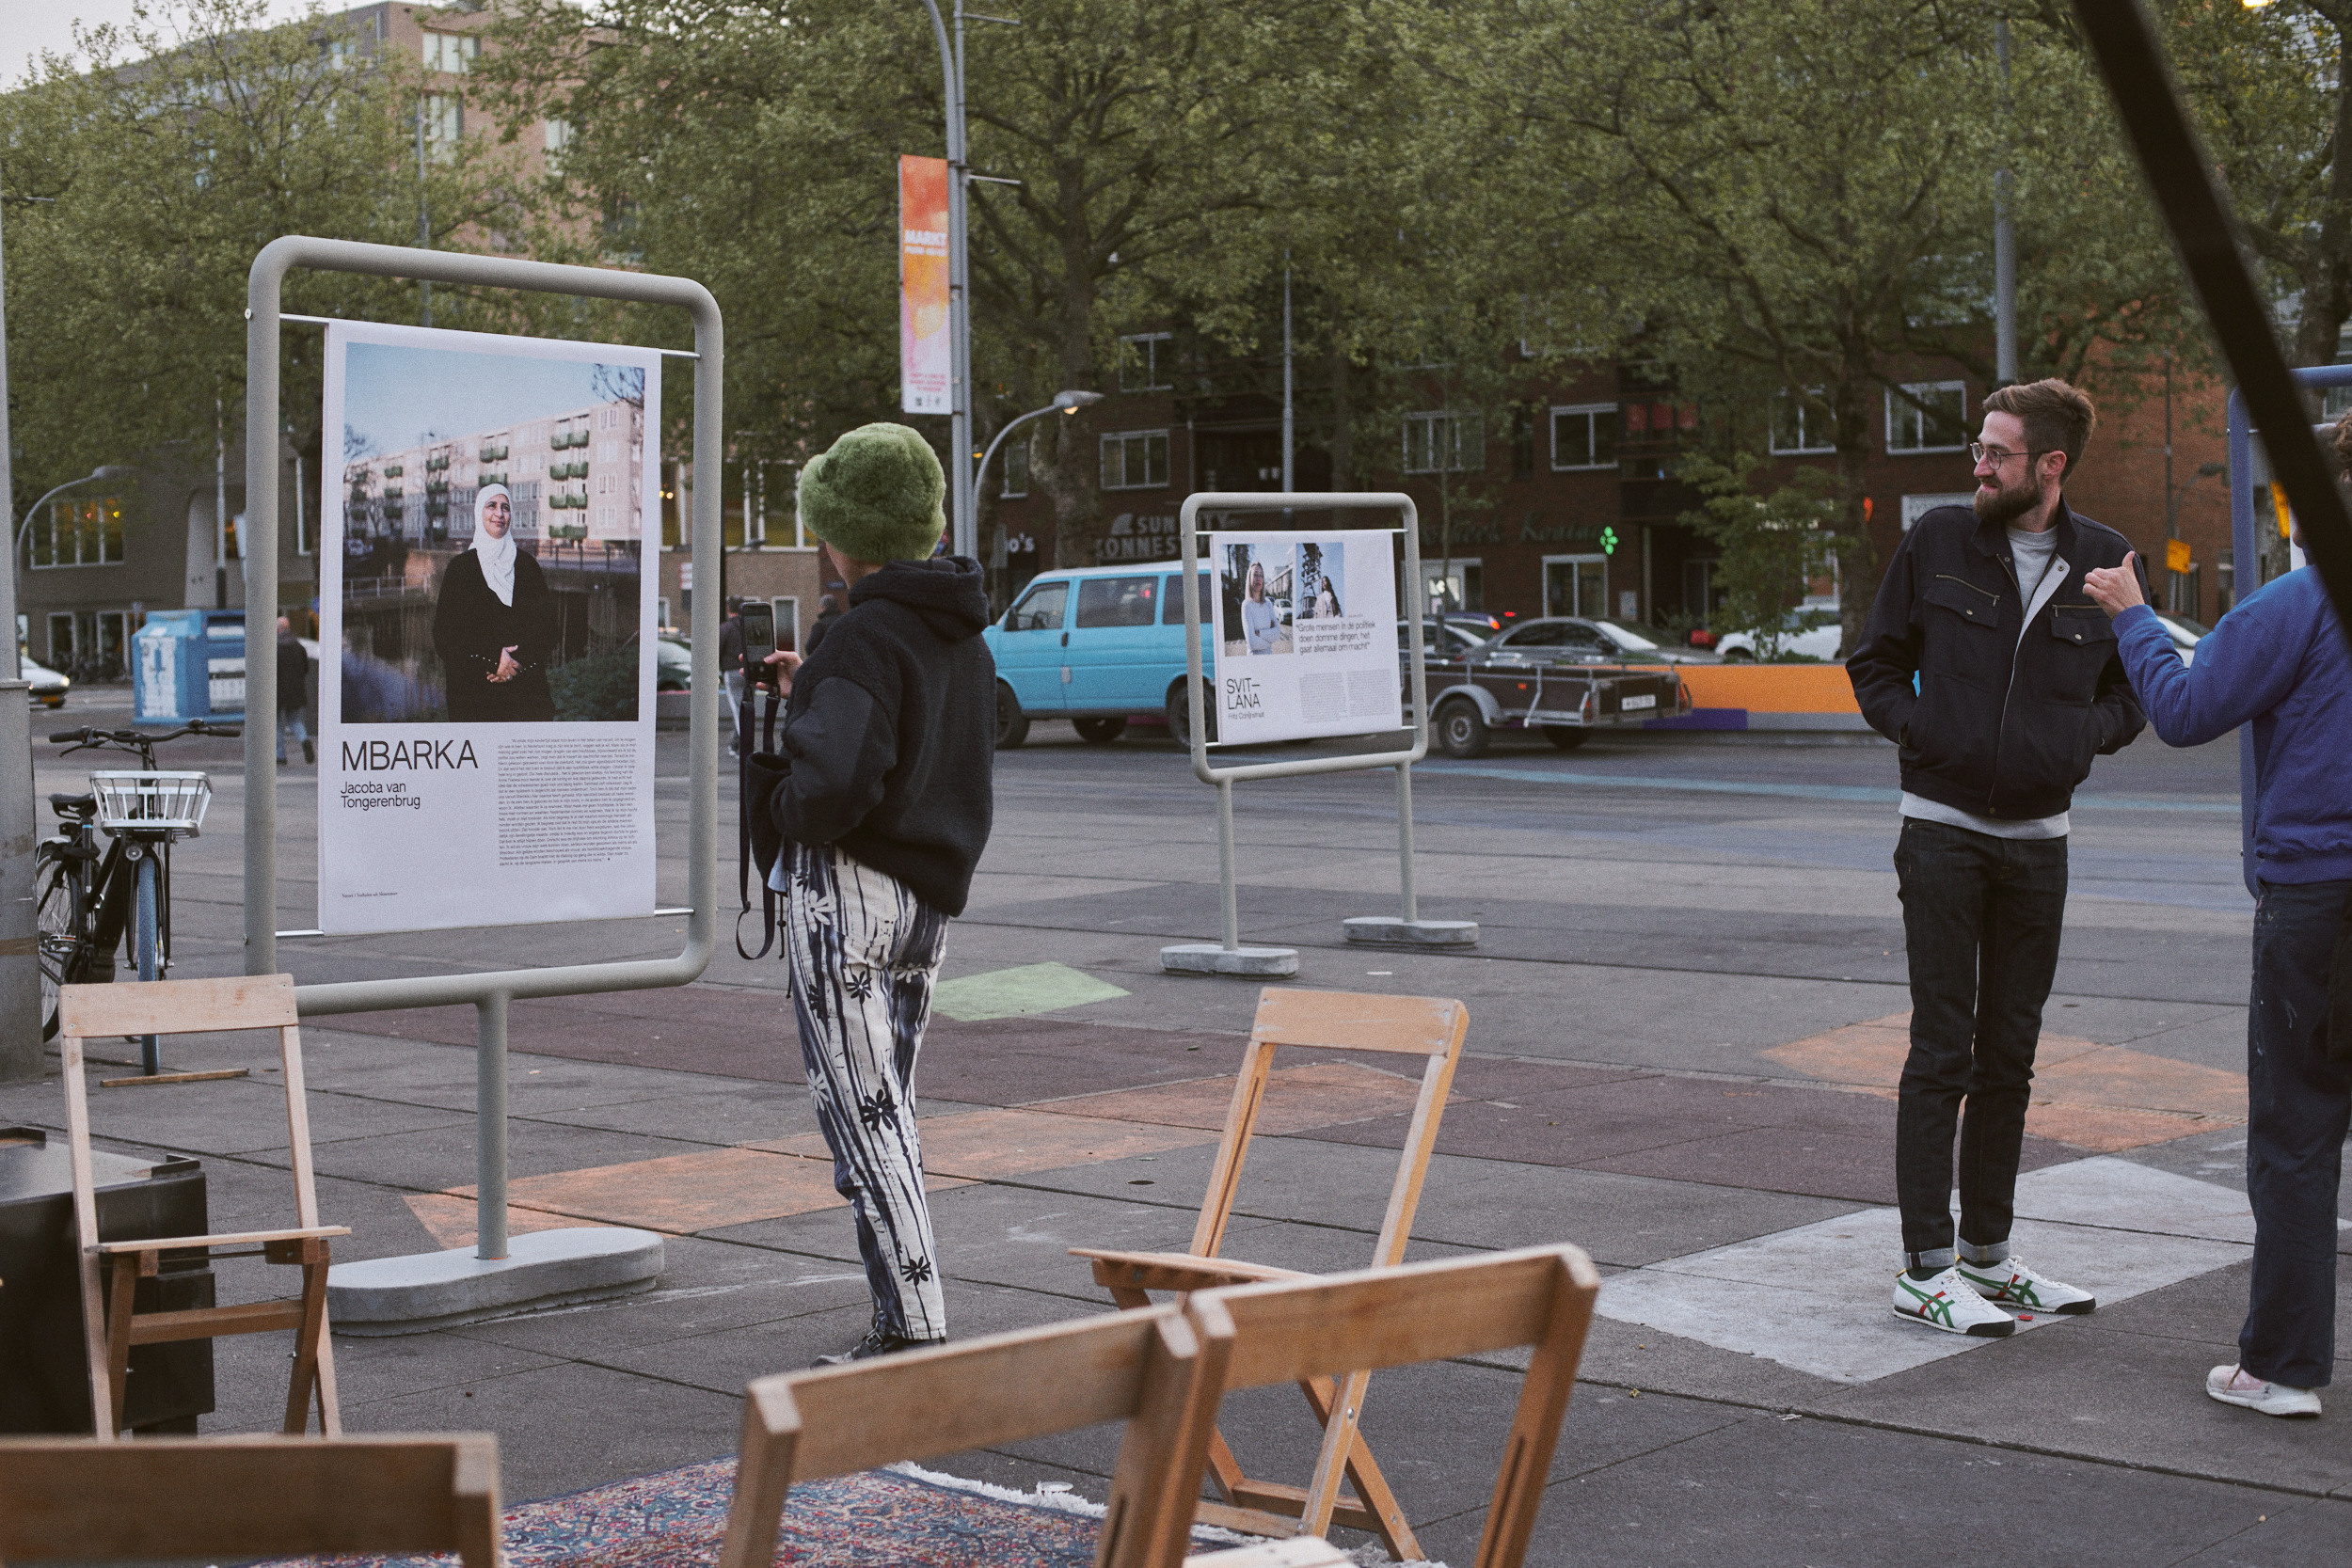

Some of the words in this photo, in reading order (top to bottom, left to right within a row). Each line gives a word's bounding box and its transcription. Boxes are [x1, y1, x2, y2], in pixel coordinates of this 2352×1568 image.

[905, 230, 946, 246] MARKT
[1136, 515, 1176, 534] SUN
[1316, 623, 1340, 632] mensen
[1341, 622, 1347, 630] in
[1347, 622, 1355, 630] de
[1356, 621, 1375, 630] politiek
[1299, 633, 1314, 643] doen
[1315, 633, 1338, 642] domme
[1360, 630, 1371, 640] het
[1299, 645, 1312, 657] gaat
[1313, 643, 1337, 653] allemaal
[1227, 693, 1262, 710] LANA
[342, 739, 479, 771] MBARKA
[341, 781, 383, 794] Jacoba
[386, 783, 406, 793] van
[341, 795, 421, 811] Tongerenbrug
